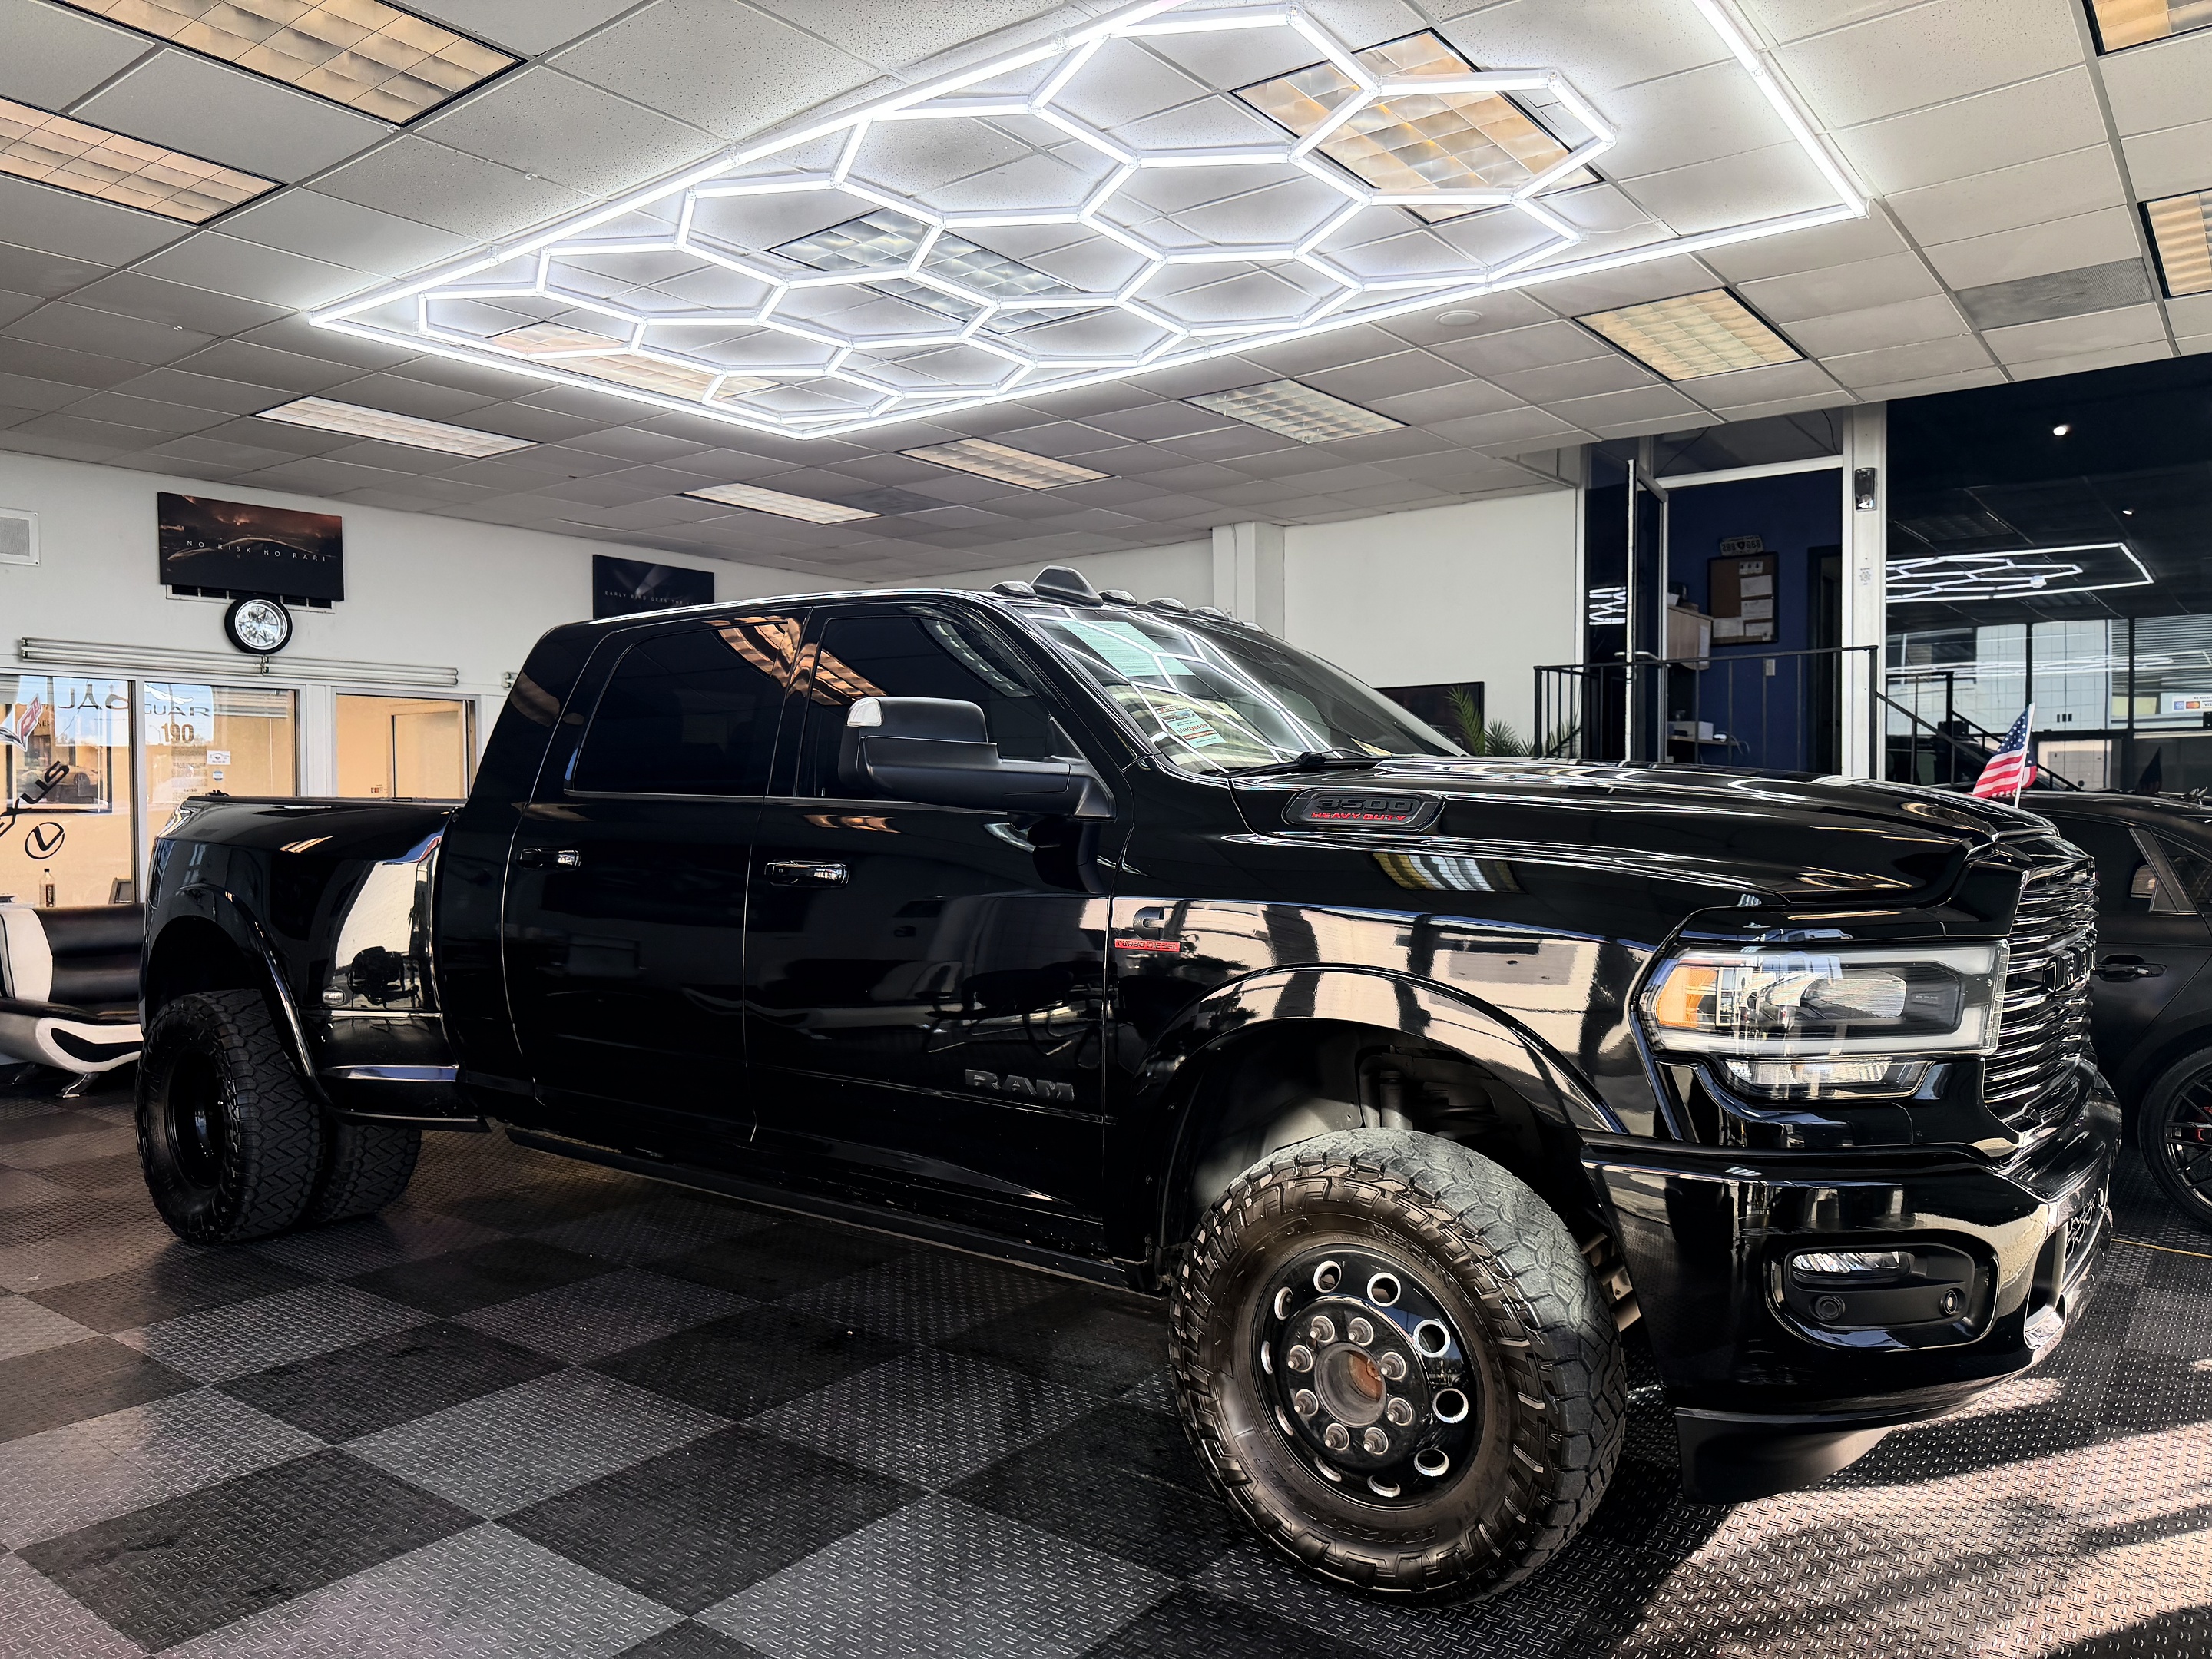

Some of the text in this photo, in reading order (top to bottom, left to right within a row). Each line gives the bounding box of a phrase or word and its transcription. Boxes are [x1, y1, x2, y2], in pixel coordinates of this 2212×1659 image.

[217, 544, 252, 553] RISK
[293, 552, 326, 561] RARI
[604, 590, 627, 598] EARLY
[161, 722, 194, 743] 190
[1316, 797, 1414, 813] 3500
[1116, 939, 1178, 950] TURBO DIESEL
[965, 1068, 1075, 1101] RAM
